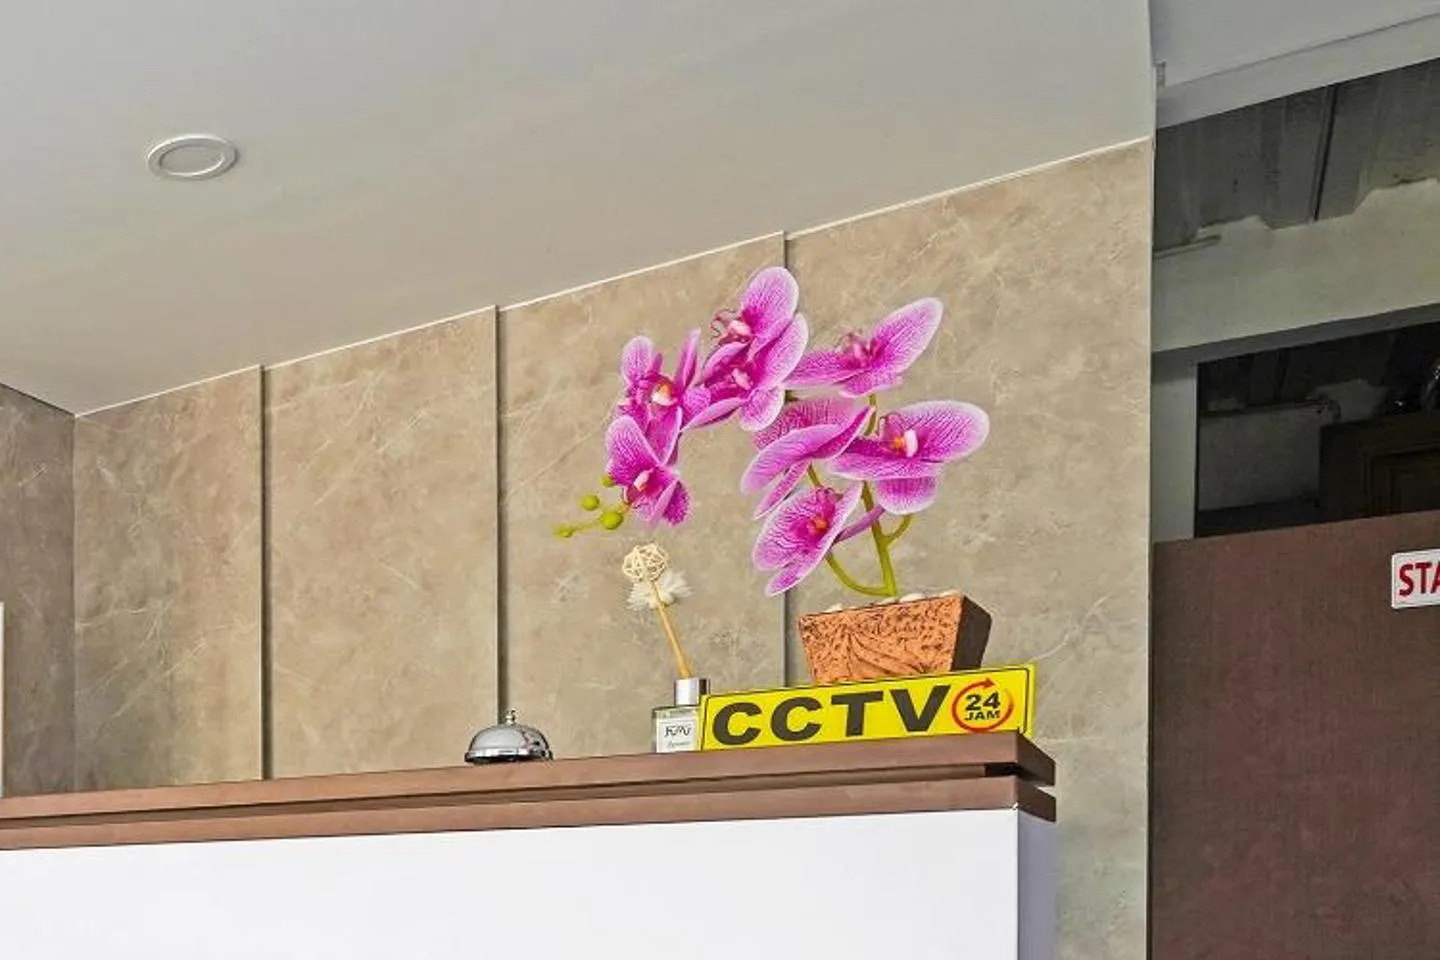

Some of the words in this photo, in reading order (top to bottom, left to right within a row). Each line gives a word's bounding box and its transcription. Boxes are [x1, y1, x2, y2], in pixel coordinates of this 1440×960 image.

[965, 691, 1001, 711] 24
[712, 684, 951, 745] CCTV
[964, 710, 1001, 721] JAM
